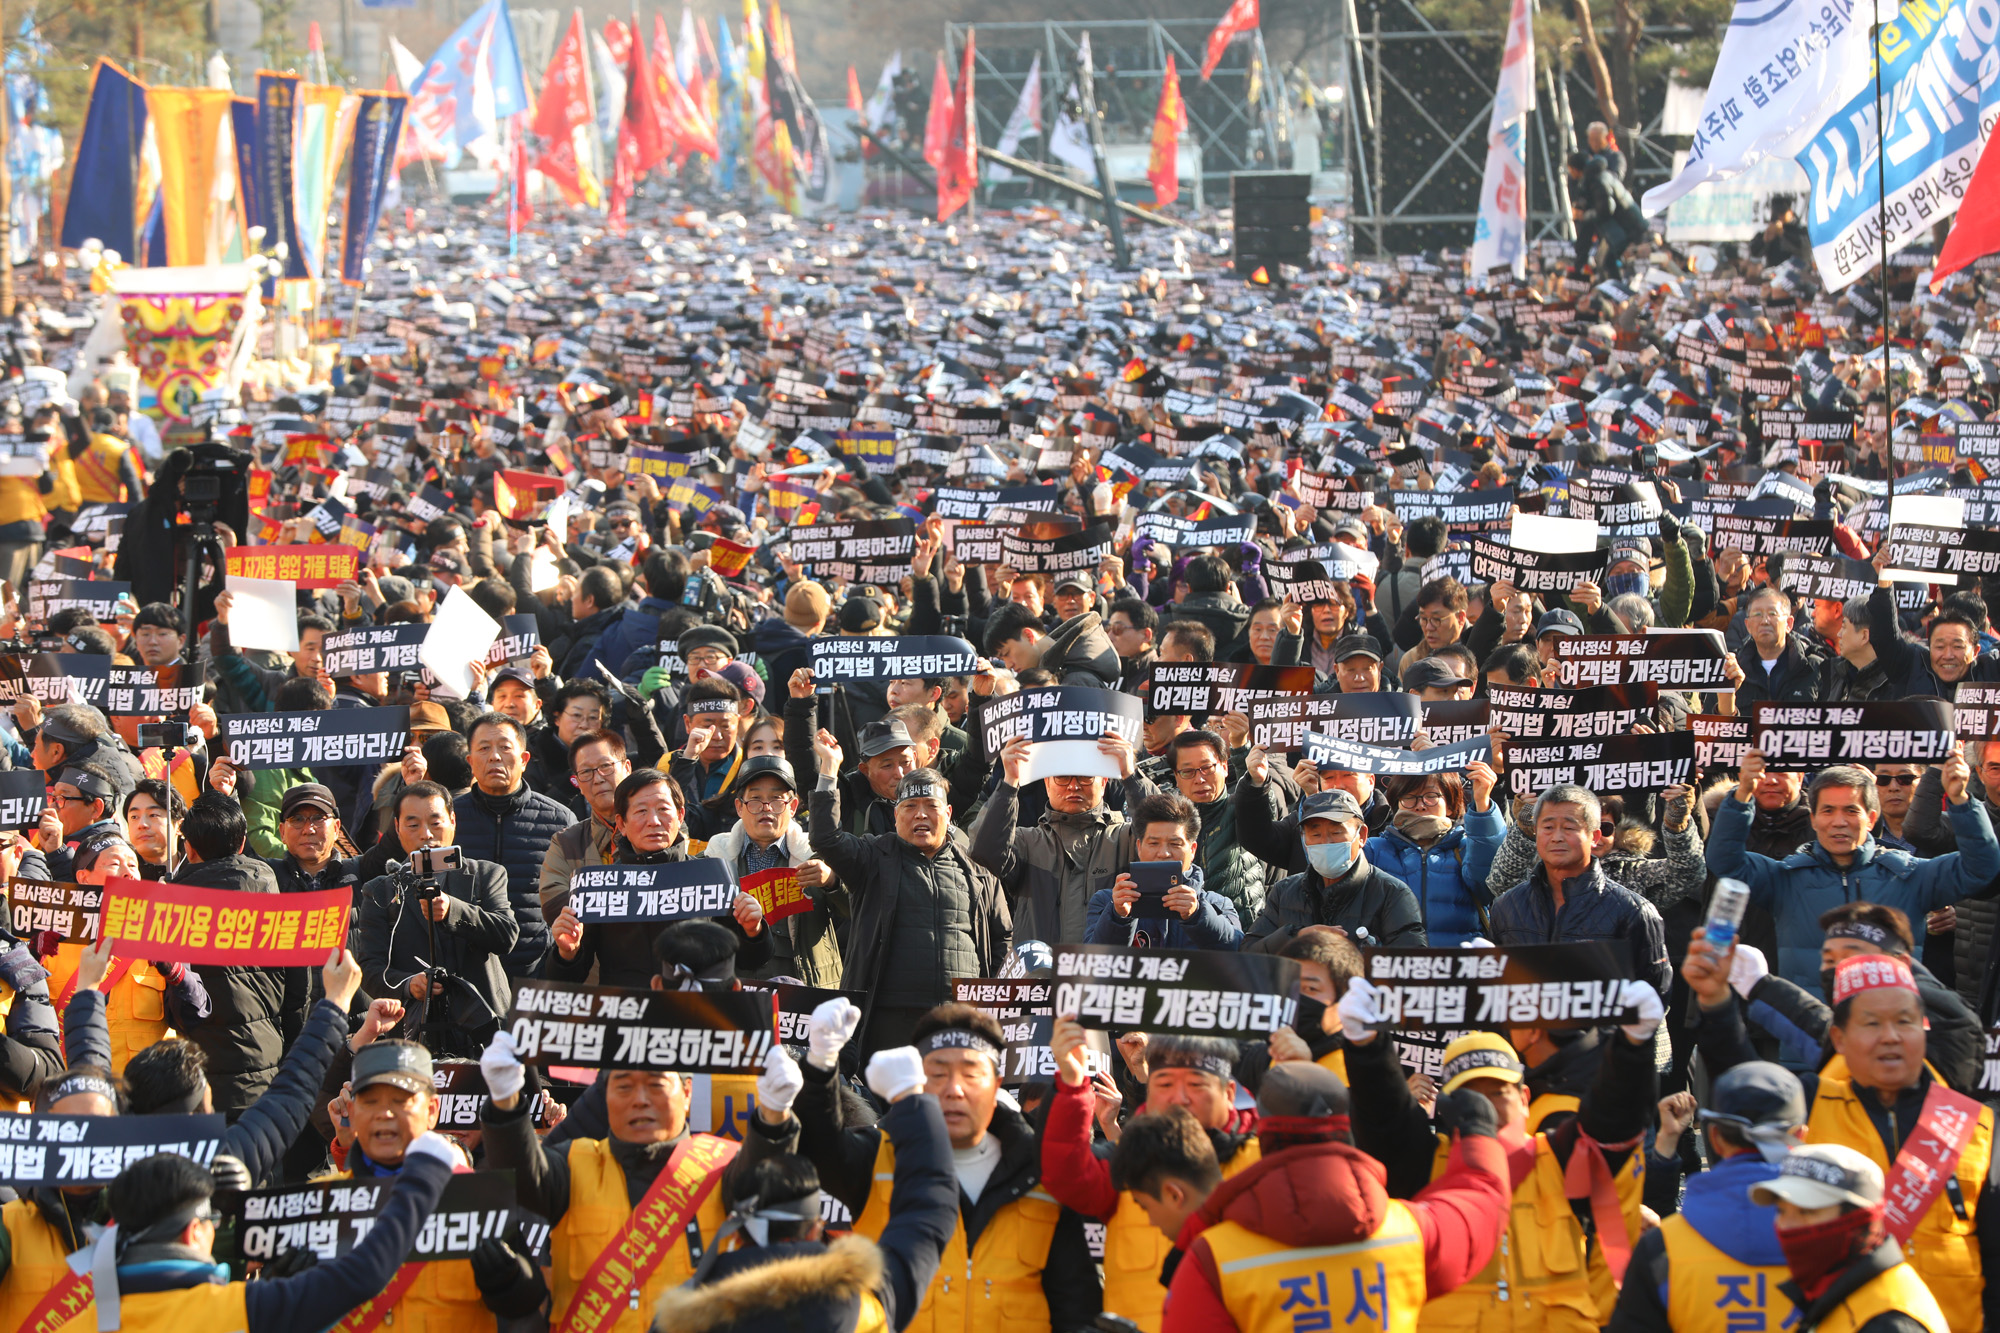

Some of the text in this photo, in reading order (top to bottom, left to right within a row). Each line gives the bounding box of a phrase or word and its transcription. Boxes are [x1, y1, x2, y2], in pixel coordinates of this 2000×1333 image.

[1761, 423, 1852, 438] 여객법 개정하라!!
[1325, 477, 1347, 490] 계승!
[1591, 486, 1613, 502] 계승!
[977, 491, 1000, 501] 계승!
[1432, 494, 1453, 504] 계승!
[936, 500, 980, 518] 여객법
[1442, 502, 1511, 522] 개정하라!!
[791, 525, 854, 540] 열사정신 계승!
[956, 528, 994, 540] 열사정신
[1716, 517, 1776, 533] 열사정신 계승!
[1892, 527, 1966, 545] 열사정신 계승!
[792, 535, 915, 564] 여객법 개정하라!!
[956, 543, 1000, 562] 여객법
[1031, 540, 1055, 553] 계승!
[1042, 542, 1111, 571] 개정하라!!
[1475, 540, 1538, 567] 열사정신 계승!
[1890, 543, 1940, 568] 여객법
[244, 555, 276, 579] 자가용
[279, 555, 301, 579] 영업
[304, 555, 326, 579] 카풀
[328, 554, 357, 579] 퇴출!
[1810, 559, 1835, 573] 계승!
[325, 628, 397, 650] 열사정신 계승!
[812, 641, 899, 655] 열사정신 계승!
[1558, 640, 1649, 656] 열사정신 계승!
[325, 648, 378, 675] 여객법
[814, 653, 978, 679] 여객법 개정하라!!
[1560, 657, 1726, 686] 여객법 개정하라!!
[129, 671, 158, 685] 계승!
[1154, 667, 1236, 683] 열사정신 계승!
[984, 692, 1061, 722] 열사정신 계승!
[1153, 686, 1209, 711] 여객법
[1253, 699, 1338, 719] 열사정신 계승!
[1490, 688, 1574, 709] 열사정신 계승!
[228, 716, 320, 735] 열사정신 계승!
[1759, 707, 1864, 725] 열사정신 계승!
[1319, 716, 1419, 744] 개정하라!!
[1692, 720, 1748, 738] 열사정신
[230, 732, 407, 765] 여객법 개정하라!!
[1308, 733, 1401, 759] 열사정신 계승!
[1508, 743, 1603, 764] 열사정신 계승!
[1760, 730, 1955, 759] 여객법 개정하라!!
[1308, 745, 1373, 771] 여객법
[1583, 758, 1692, 792] 개정하라!!
[570, 870, 658, 888] 열사정신 계승!
[14, 882, 102, 907] 열사정신 계승!
[14, 905, 76, 939] 여객법
[104, 894, 349, 951] 불법 자가용 영업 카풀 퇴출!
[1057, 952, 1189, 981] 열사정신 계승!
[1371, 955, 1509, 979] 열사정신 계승!
[516, 987, 649, 1021] 열사정신 계승!
[957, 984, 1051, 1002] 열사정신 계승!
[1377, 979, 1631, 1023] 여객법 개정하라!!
[1056, 983, 1299, 1033] 여객법 개정하라!!
[512, 1017, 773, 1068] 여객법 개정하라!!
[1002, 1022, 1037, 1042] 계승!
[37, 1120, 90, 1142] 계승!
[244, 1186, 381, 1221] 열사정신 계승!
